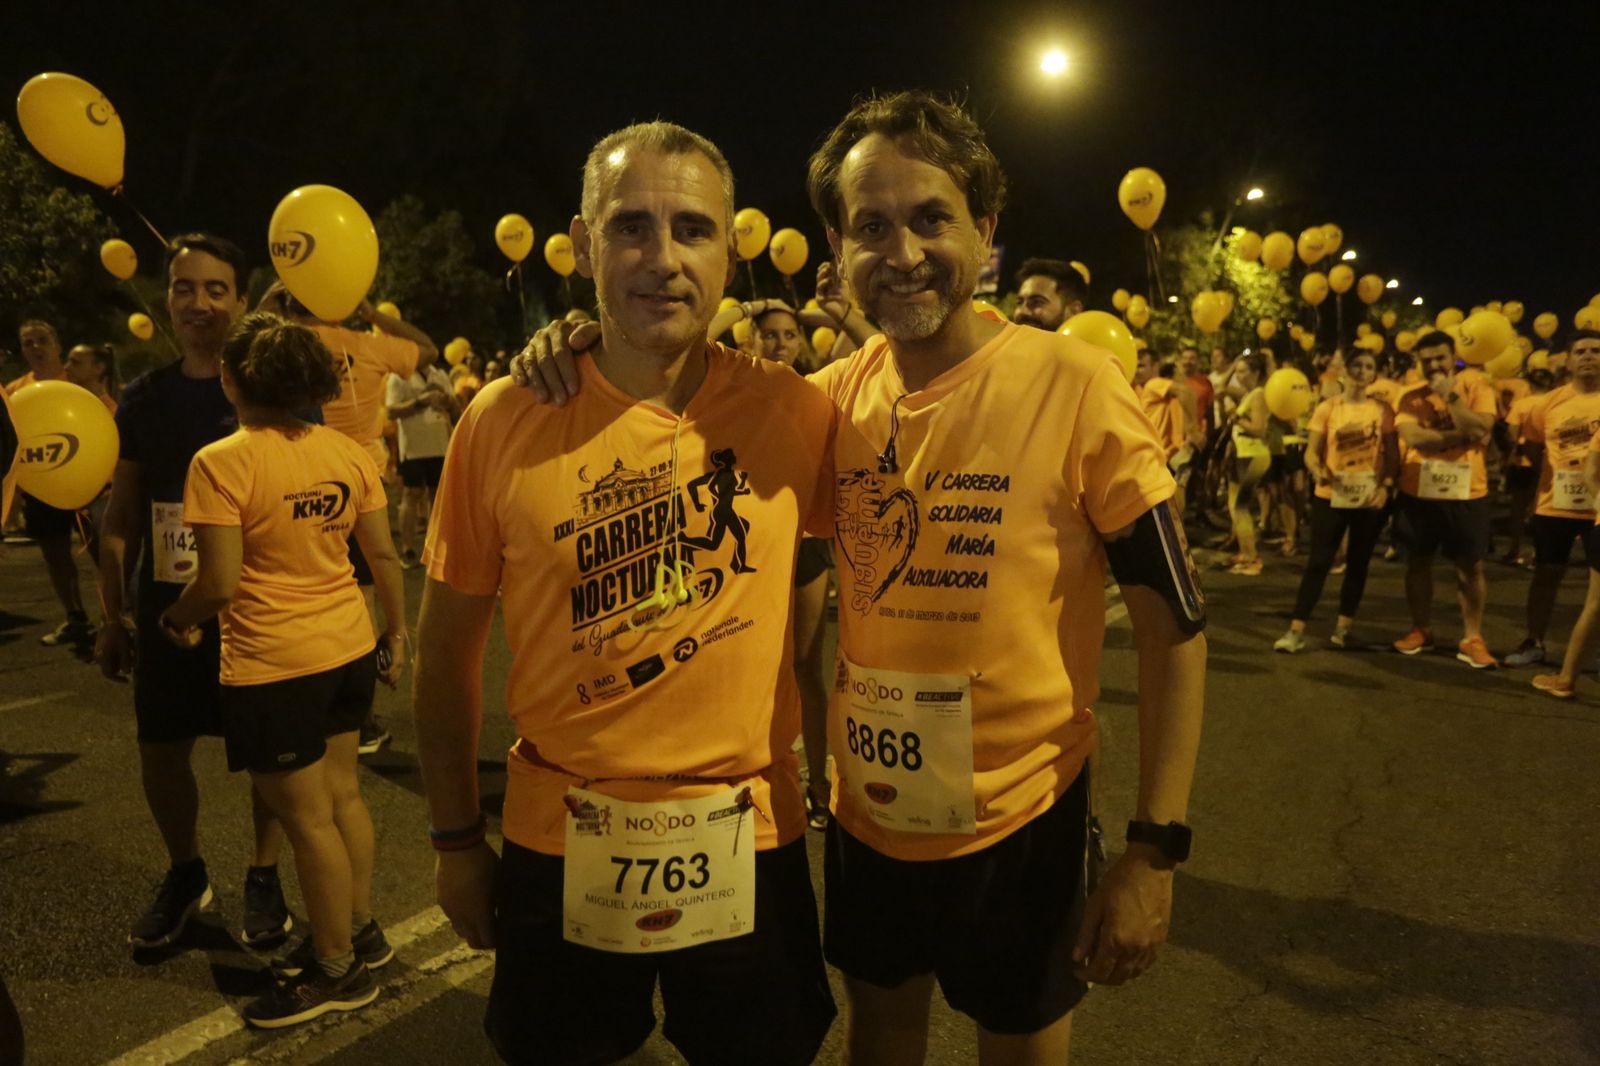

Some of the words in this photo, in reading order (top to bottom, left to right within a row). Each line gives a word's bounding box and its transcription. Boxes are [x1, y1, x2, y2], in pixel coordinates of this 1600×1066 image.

[924, 470, 940, 492] V
[941, 473, 1011, 493] CARRERA
[928, 504, 1003, 525] SOLIDARIA
[162, 531, 199, 553] 1142
[554, 518, 575, 543] XXXI
[576, 493, 687, 573] CARRERA
[571, 637, 586, 653] del
[593, 674, 616, 690] IMD
[846, 716, 923, 772] 8868
[610, 852, 711, 896] 7763
[585, 893, 627, 911] MIGUEL
[675, 887, 736, 907] QUINTERO
